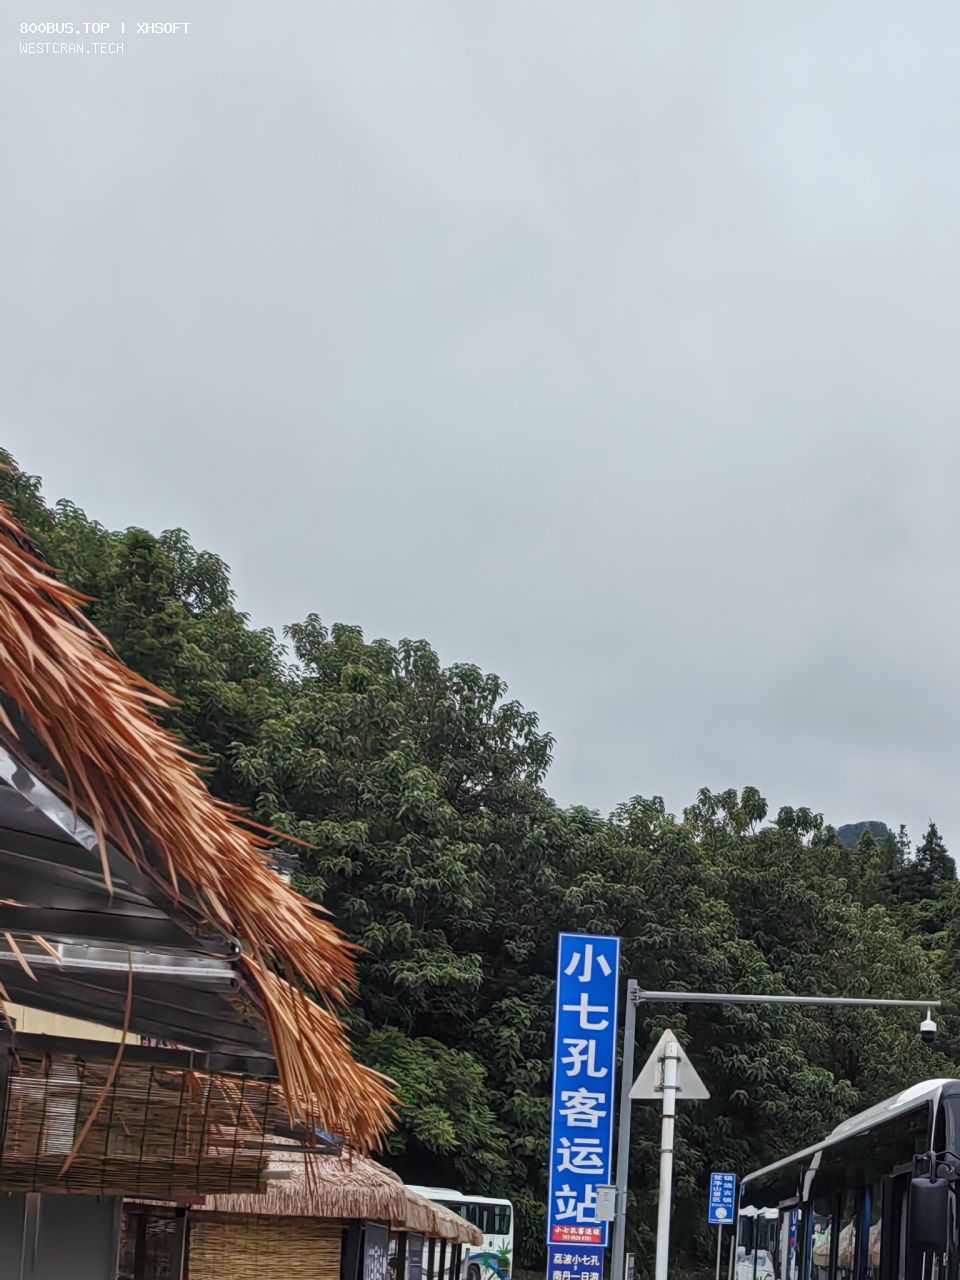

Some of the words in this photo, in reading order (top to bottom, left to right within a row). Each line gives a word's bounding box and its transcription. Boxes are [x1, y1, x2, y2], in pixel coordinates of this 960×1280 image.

[554, 943, 612, 1224] 小七孔客运站
[553, 1253, 600, 1266] 荔波小七孔
